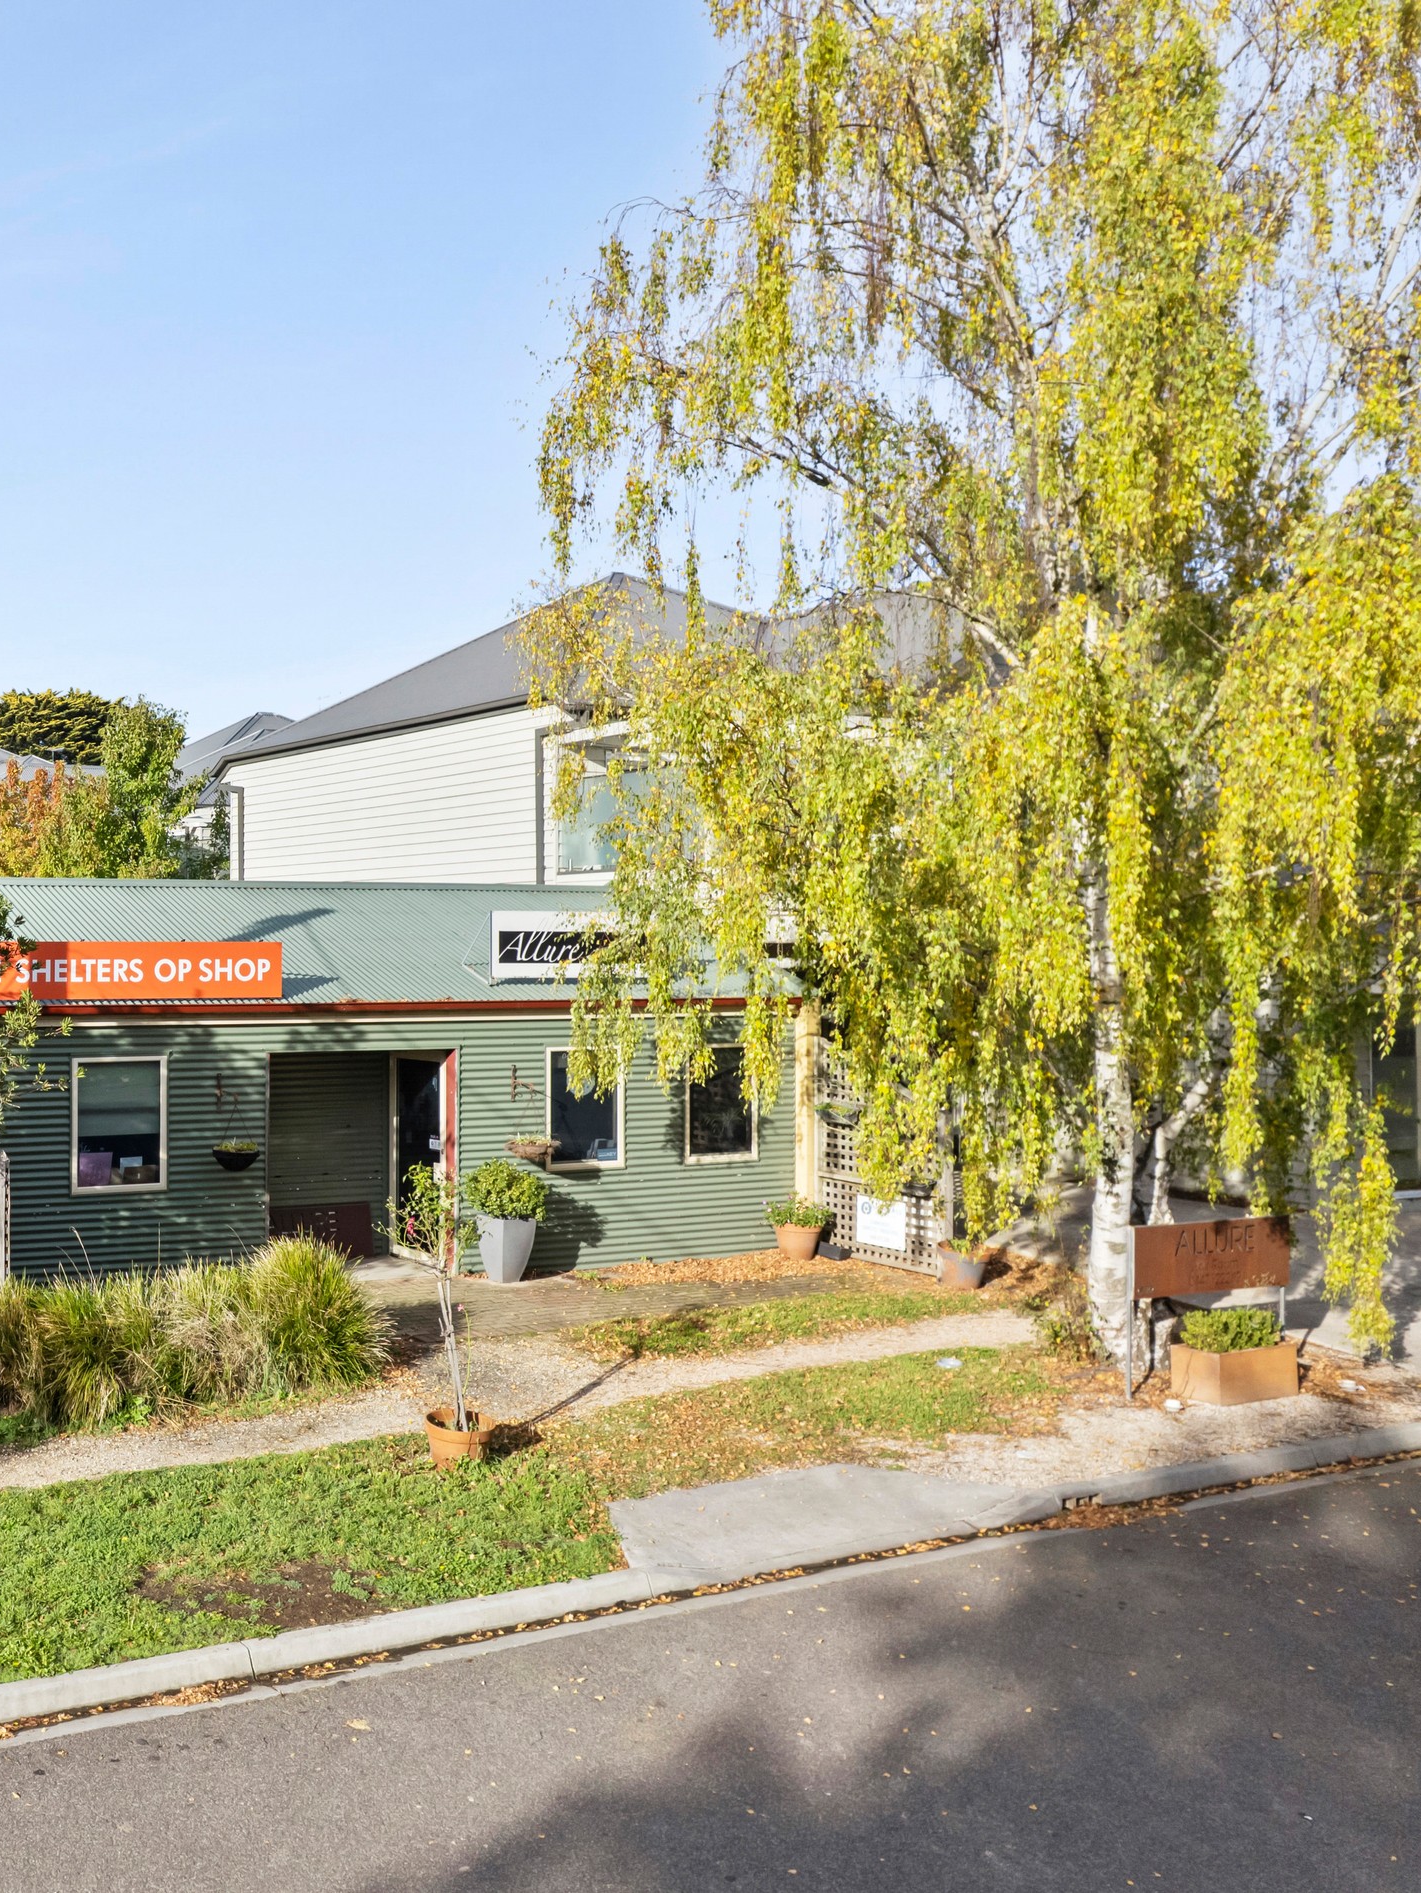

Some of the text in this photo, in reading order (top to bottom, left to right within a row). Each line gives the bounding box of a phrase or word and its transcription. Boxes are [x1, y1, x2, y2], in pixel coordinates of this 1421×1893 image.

[498, 917, 583, 962] Allure
[15, 958, 143, 983] SHELTERS
[154, 958, 192, 983] OP
[199, 958, 271, 982] SHOP
[1175, 1225, 1255, 1257] ALLURE
